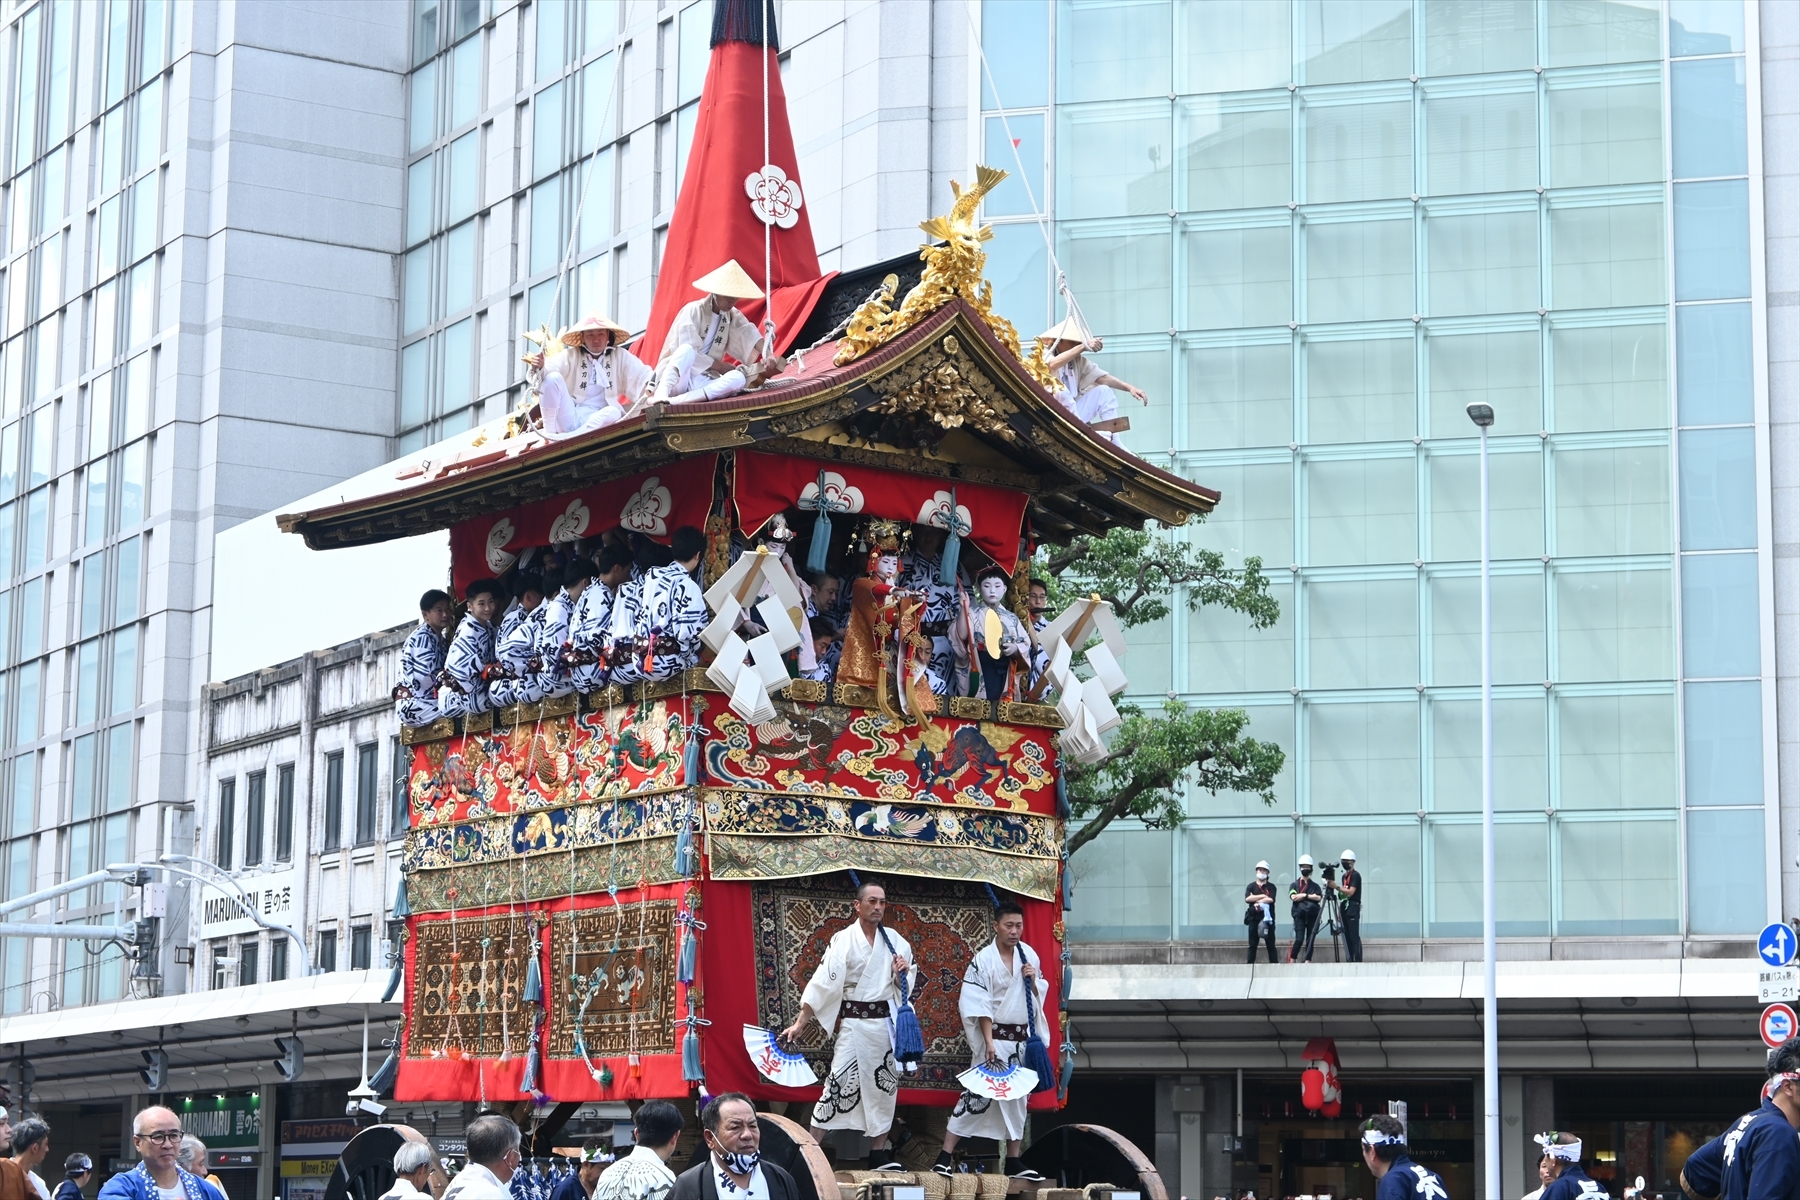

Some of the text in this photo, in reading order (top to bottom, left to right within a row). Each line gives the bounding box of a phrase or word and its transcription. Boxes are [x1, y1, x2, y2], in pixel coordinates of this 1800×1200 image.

[264, 886, 290, 915] 雲の茶
[1406, 1147, 1445, 1157] himaya
[301, 1161, 319, 1175] Money
